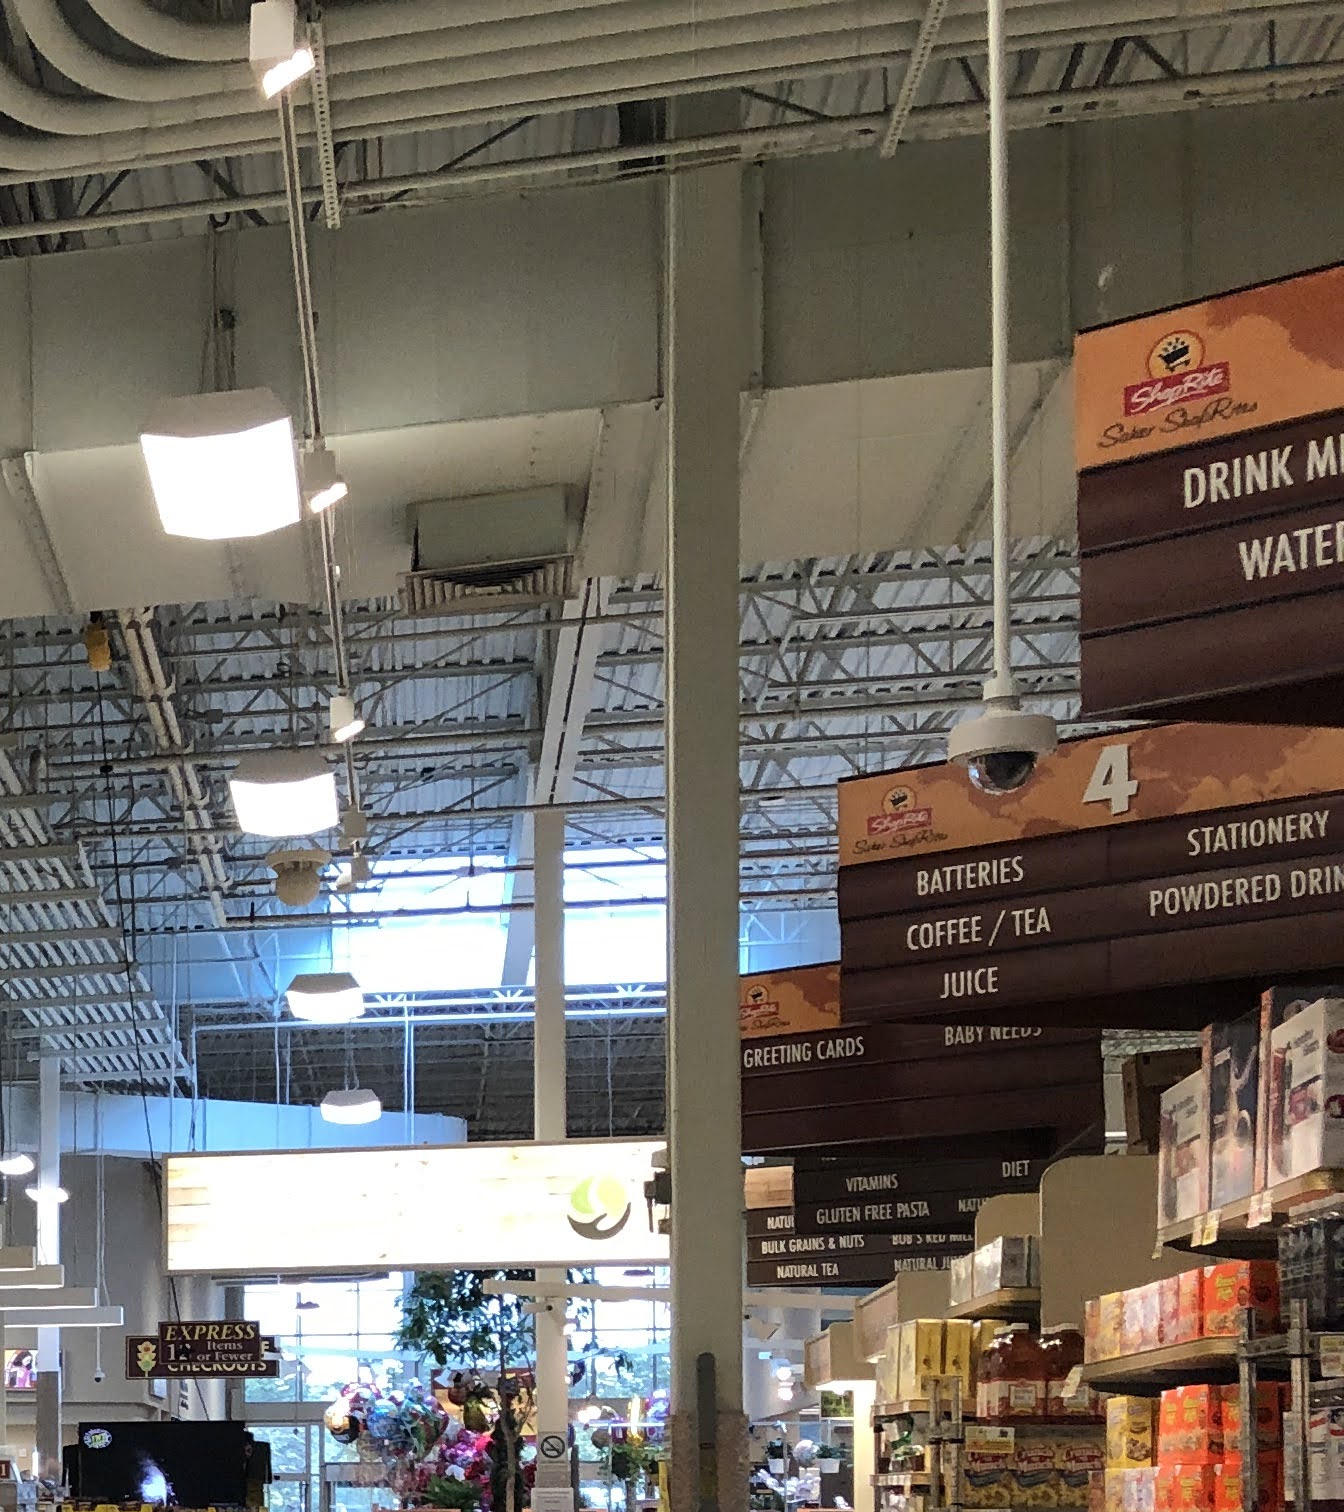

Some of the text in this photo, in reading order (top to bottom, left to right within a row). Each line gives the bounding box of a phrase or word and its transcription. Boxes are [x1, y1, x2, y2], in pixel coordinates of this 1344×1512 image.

[1183, 445, 1294, 509] DRINK
[1082, 743, 1139, 816] 4
[1187, 810, 1329, 857] STATIONERY
[917, 856, 1024, 896] BATTERIES
[1149, 873, 1281, 917] POWDERED
[906, 915, 982, 951] COFFEE
[1011, 907, 1051, 936] TEA
[940, 966, 999, 999] JUICE
[944, 1026, 983, 1046] BABY
[743, 1036, 864, 1068] GREETING CARDS
[1002, 1160, 1030, 1178] DIET
[846, 1173, 898, 1192] VITAMINS
[816, 1201, 930, 1225] GLUTEN FREE PASTA
[762, 1240, 786, 1254] BULK
[789, 1236, 825, 1252] GRAINS
[839, 1235, 864, 1249] NUTS
[777, 1263, 839, 1278] NATURAL TEA
[165, 1324, 256, 1341] EXPRESS
[197, 1352, 253, 1361] or Fewer
[207, 1341, 243, 1351] Items
[0, 1464, 7, 1476] 1
